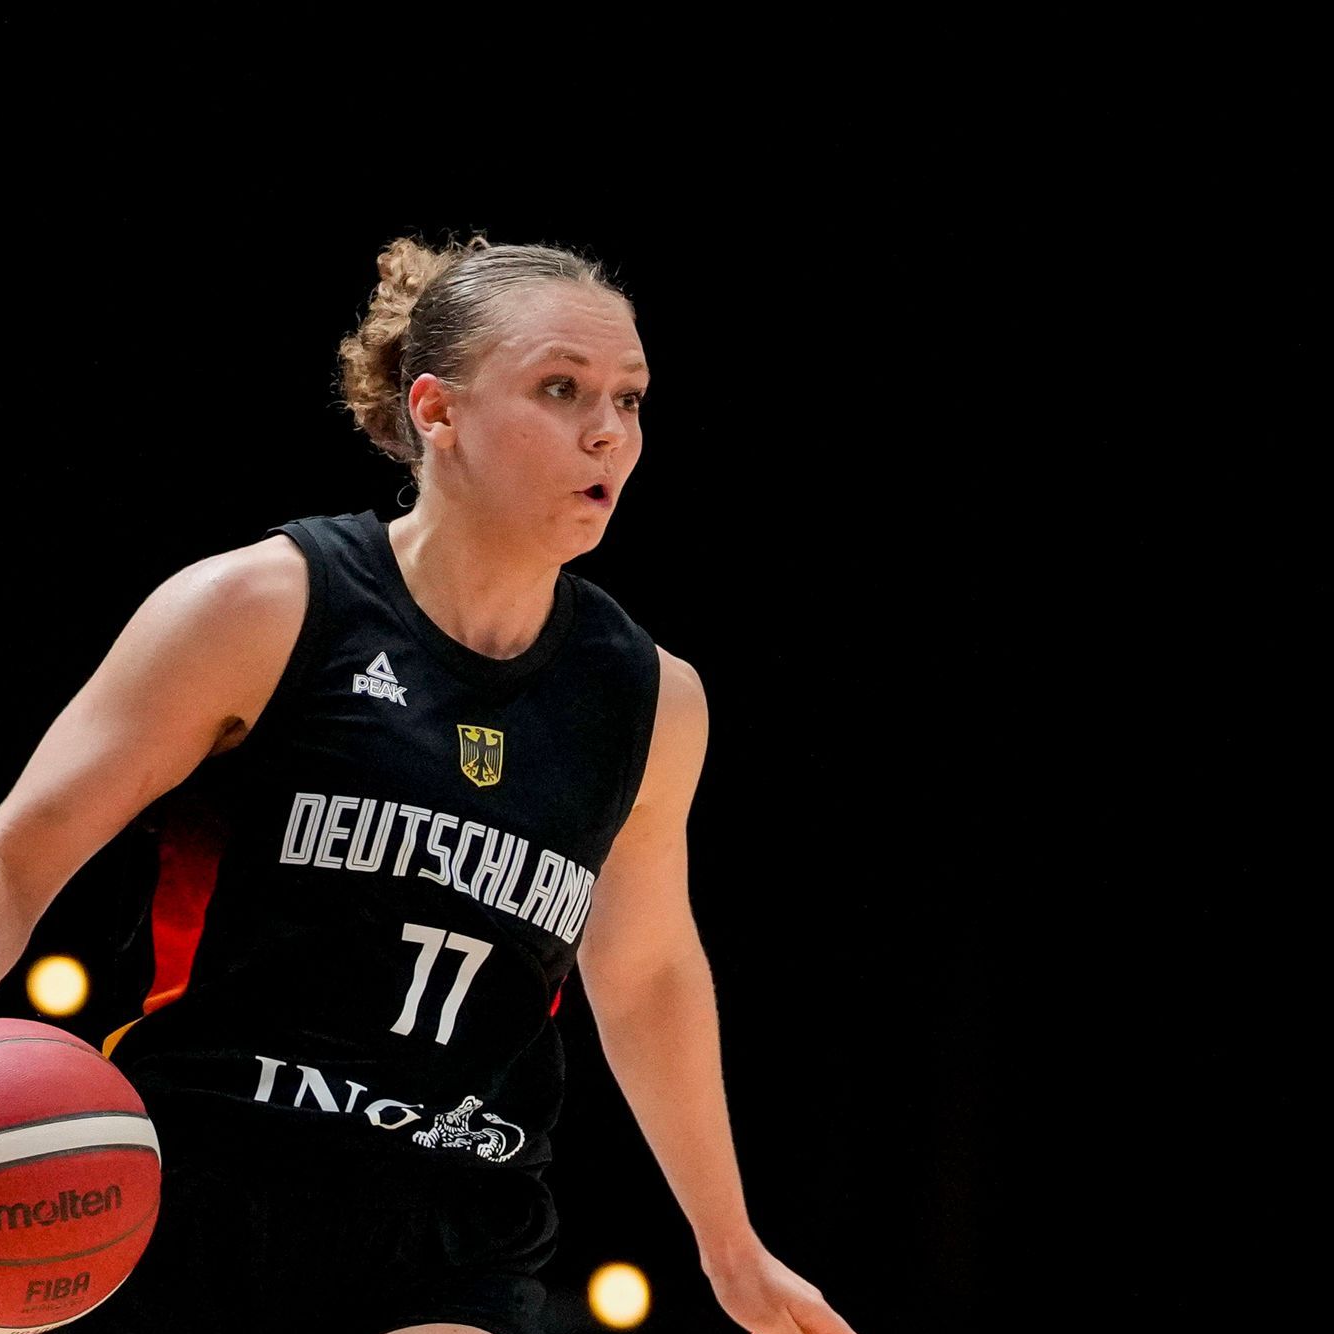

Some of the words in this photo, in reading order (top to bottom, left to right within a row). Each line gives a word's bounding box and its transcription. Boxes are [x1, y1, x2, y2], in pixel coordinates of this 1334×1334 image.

[352, 673, 408, 707] PEAK
[279, 792, 595, 945] DEUTSCHLAND
[389, 922, 494, 1046] 77
[253, 1055, 424, 1130] ING
[25, 1271, 91, 1302] FIBA
